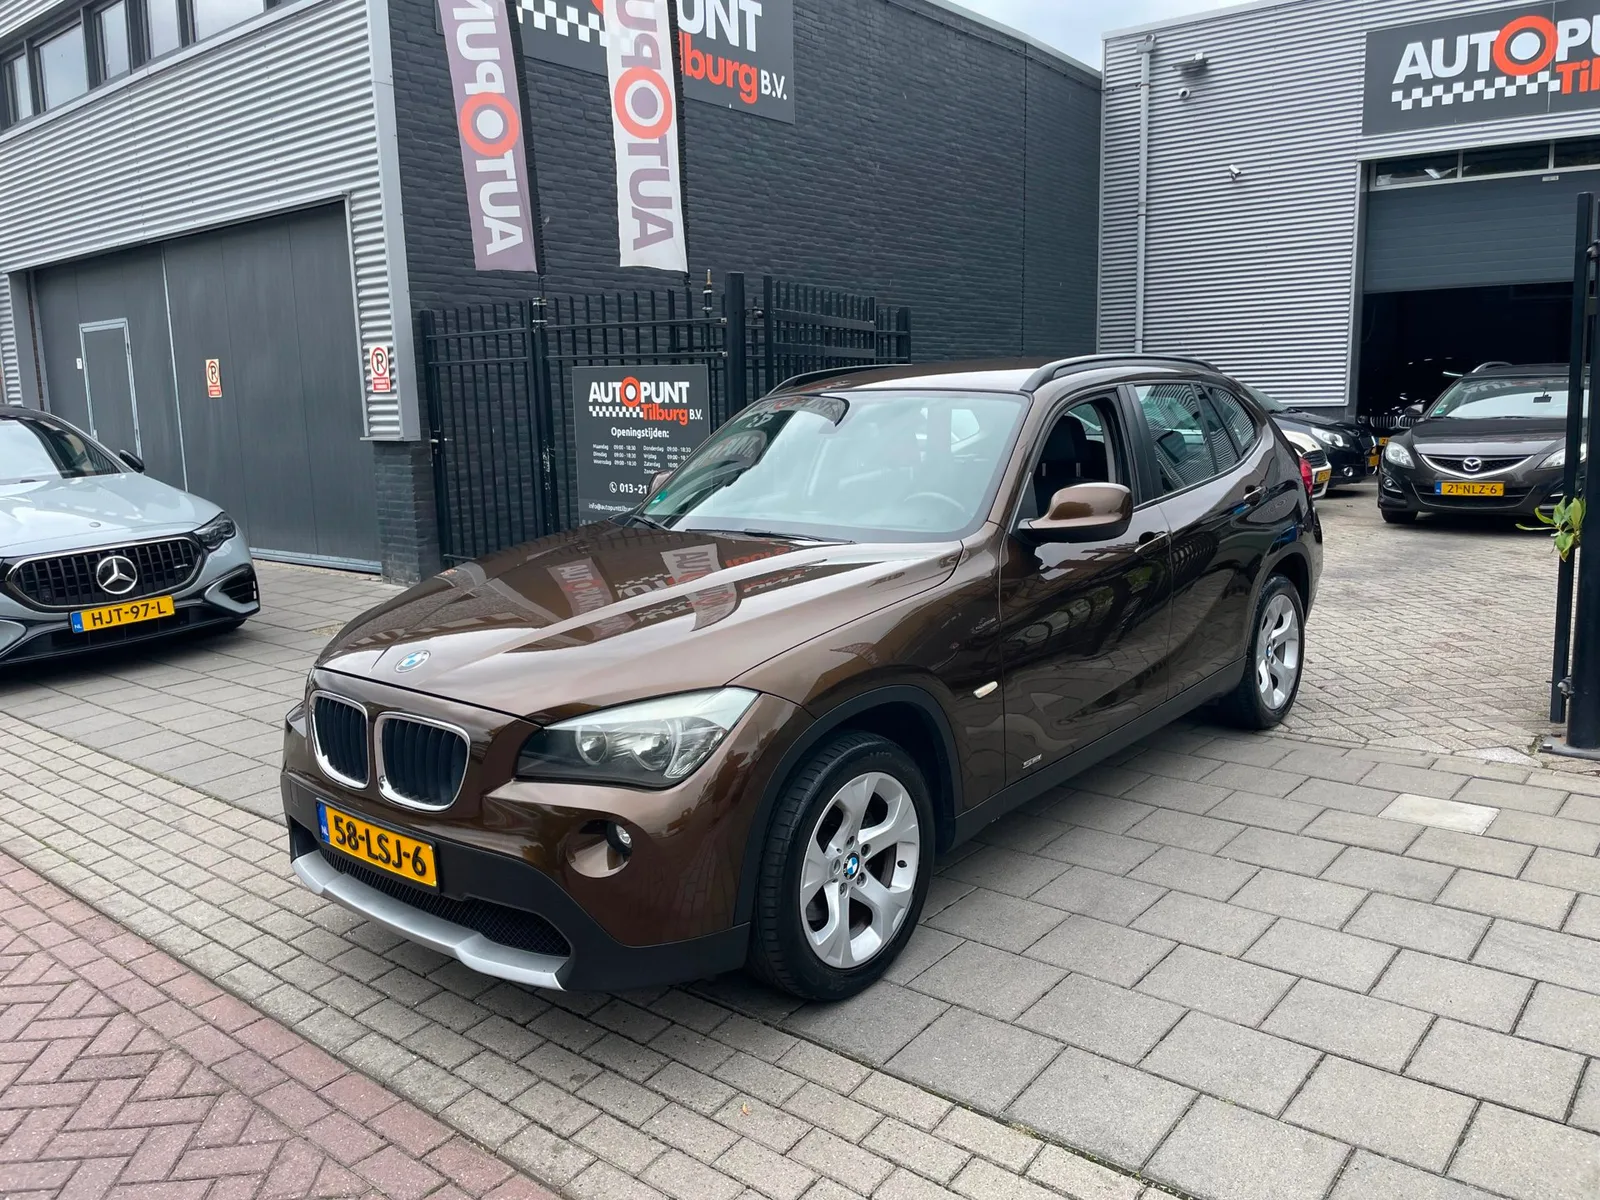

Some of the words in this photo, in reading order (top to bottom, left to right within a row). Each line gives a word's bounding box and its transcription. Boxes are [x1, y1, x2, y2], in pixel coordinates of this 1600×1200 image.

[1392, 15, 1600, 85] AUTOP
[761, 69, 788, 101] B.V.
[588, 376, 690, 408] AUTOPUNT
[641, 403, 689, 426] Tilburg
[689, 408, 703, 421] B.V.
[611, 426, 670, 440] Openingstijden:
[619, 483, 649, 495] 013-21
[1447, 484, 1498, 495] 21-NLZ-6
[91, 601, 167, 627] HJT-97-L
[333, 815, 427, 877] 58-LSJ-6
